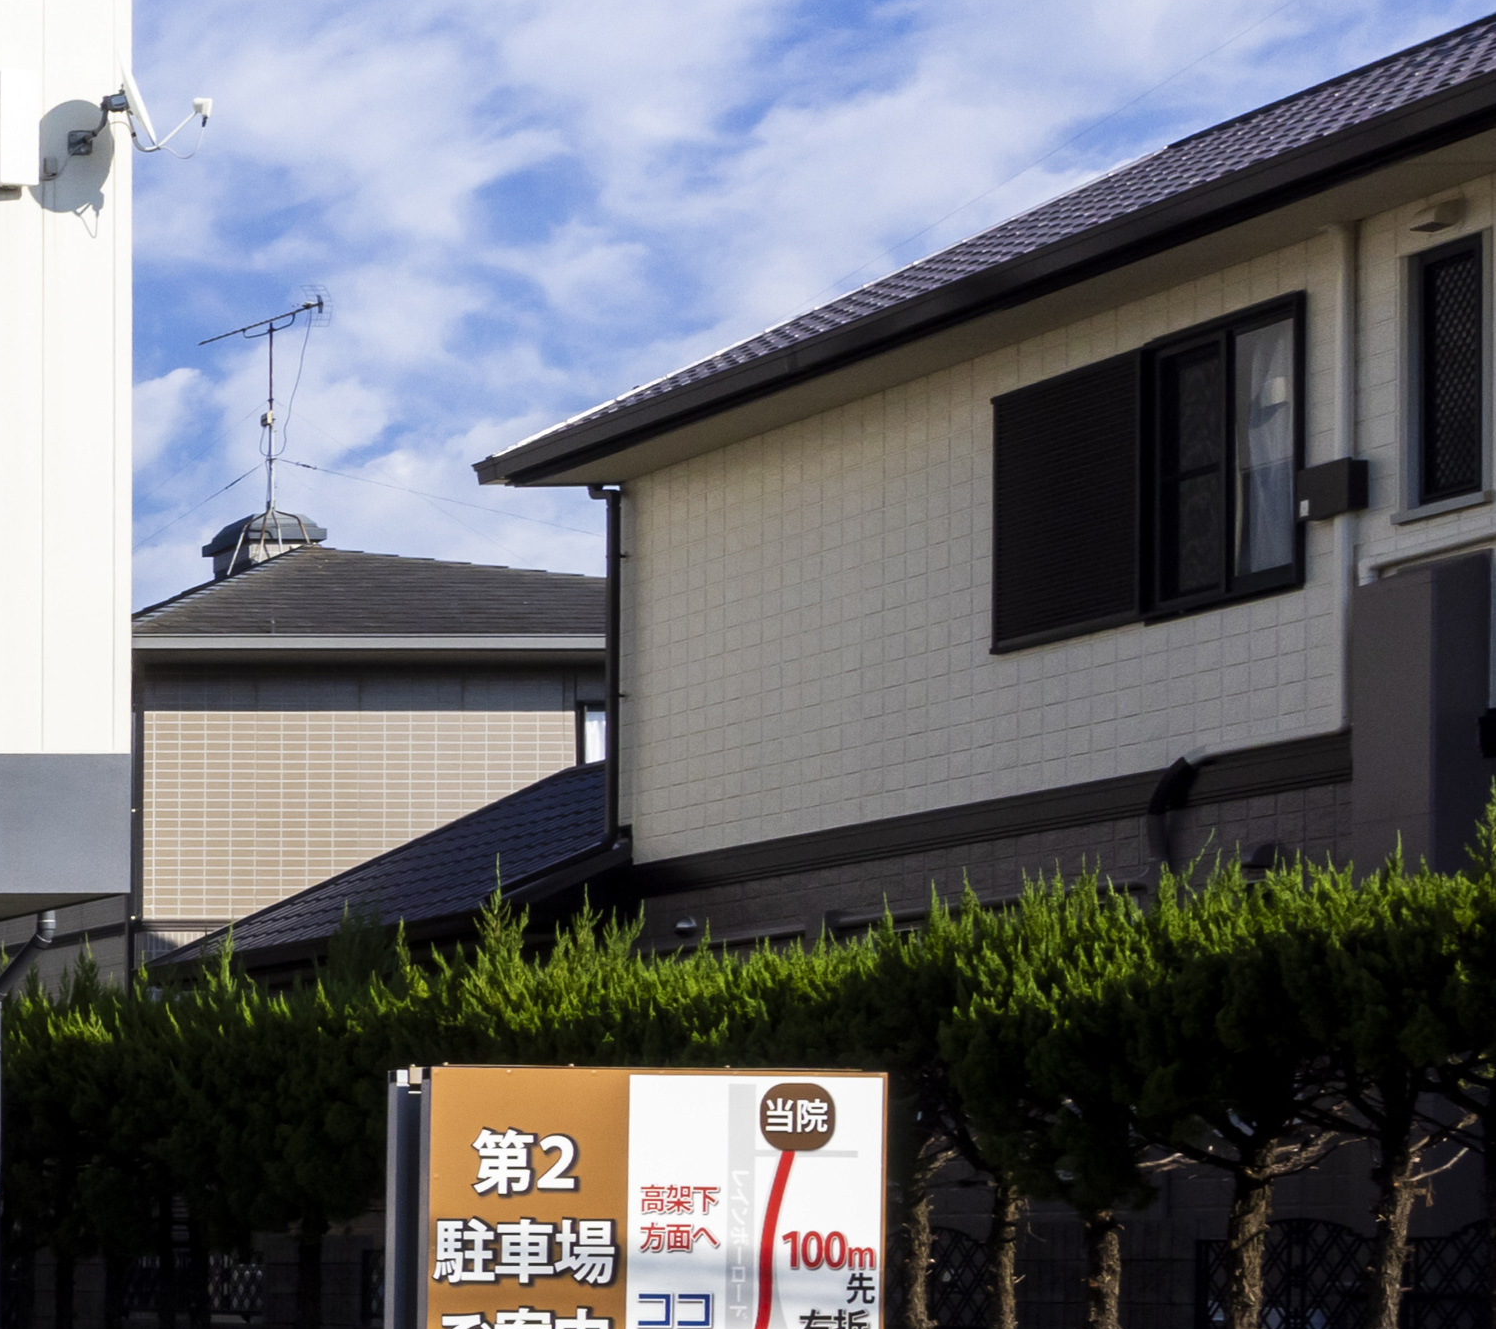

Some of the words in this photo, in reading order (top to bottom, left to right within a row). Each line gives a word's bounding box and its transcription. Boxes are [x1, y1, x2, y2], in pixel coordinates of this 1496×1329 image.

[765, 1100, 829, 1133] 当院
[471, 1127, 577, 1196] 第2
[640, 1185, 719, 1214] 高架下
[432, 1217, 616, 1286] 駐車場
[640, 1223, 719, 1252] 方面へ
[729, 1170, 750, 1319] レインボーロード
[782, 1231, 876, 1269] 100m
[846, 1272, 875, 1304] 先
[637, 1292, 712, 1328] ココ
